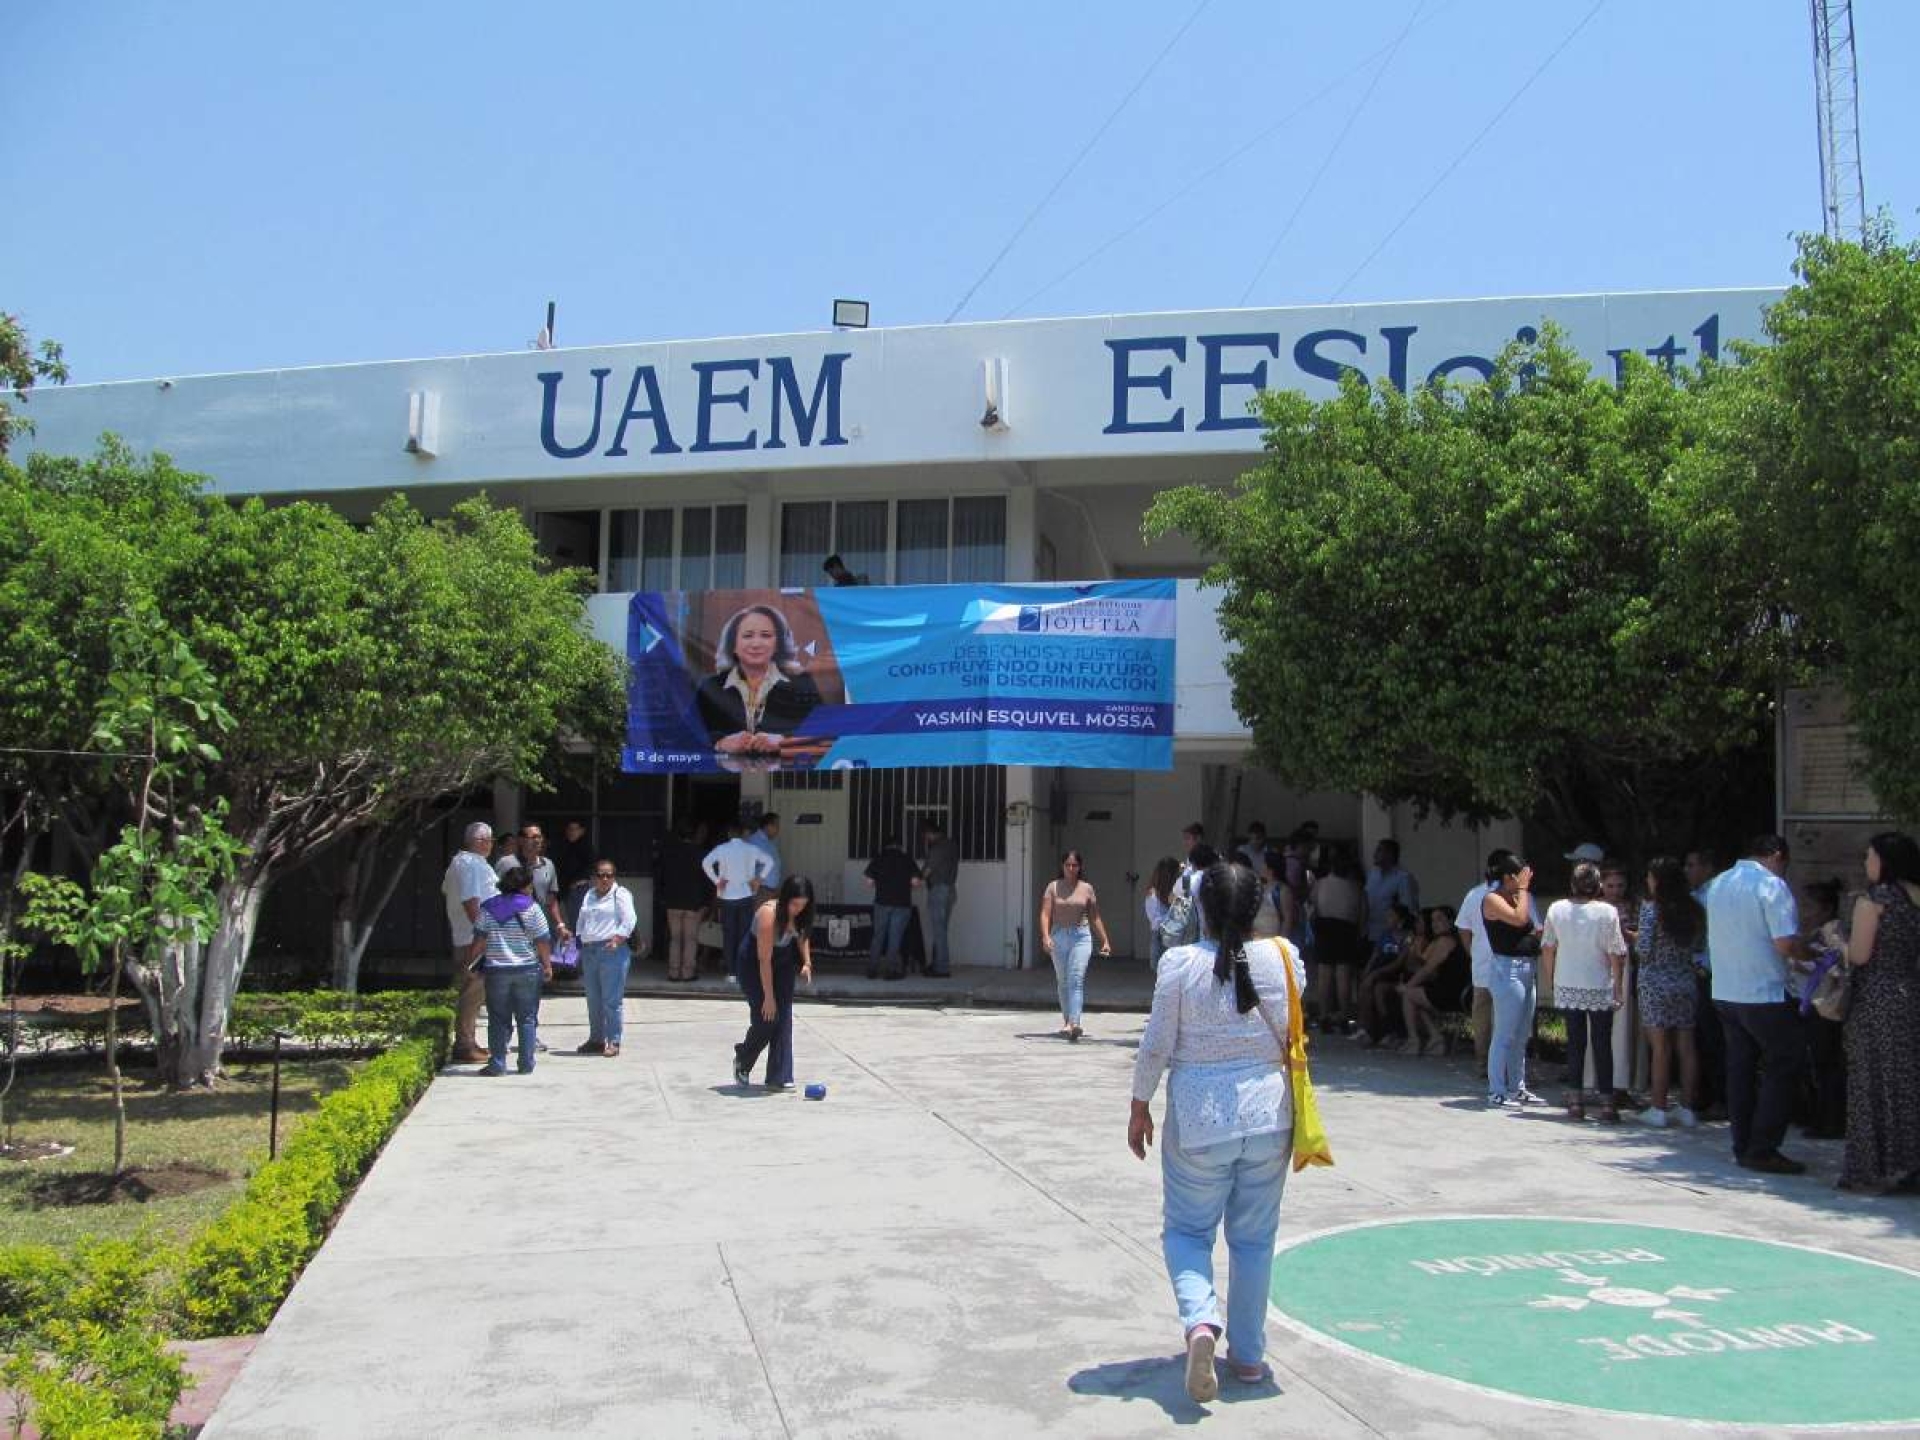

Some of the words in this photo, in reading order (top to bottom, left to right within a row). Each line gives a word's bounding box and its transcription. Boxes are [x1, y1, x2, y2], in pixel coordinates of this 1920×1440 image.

[537, 352, 852, 459] UAEM
[1043, 614, 1140, 632] JOJUTLA
[888, 660, 1039, 678] CONSTRUYENDO
[1046, 661, 1073, 674] UN
[1079, 662, 1158, 677] FUTURO
[961, 674, 989, 687] SIN
[915, 706, 983, 726] YASMÍN
[988, 709, 1080, 727] ESQUIVEL
[1085, 713, 1155, 729] MOSSA
[648, 752, 664, 763] de
[668, 754, 702, 763] mayo
